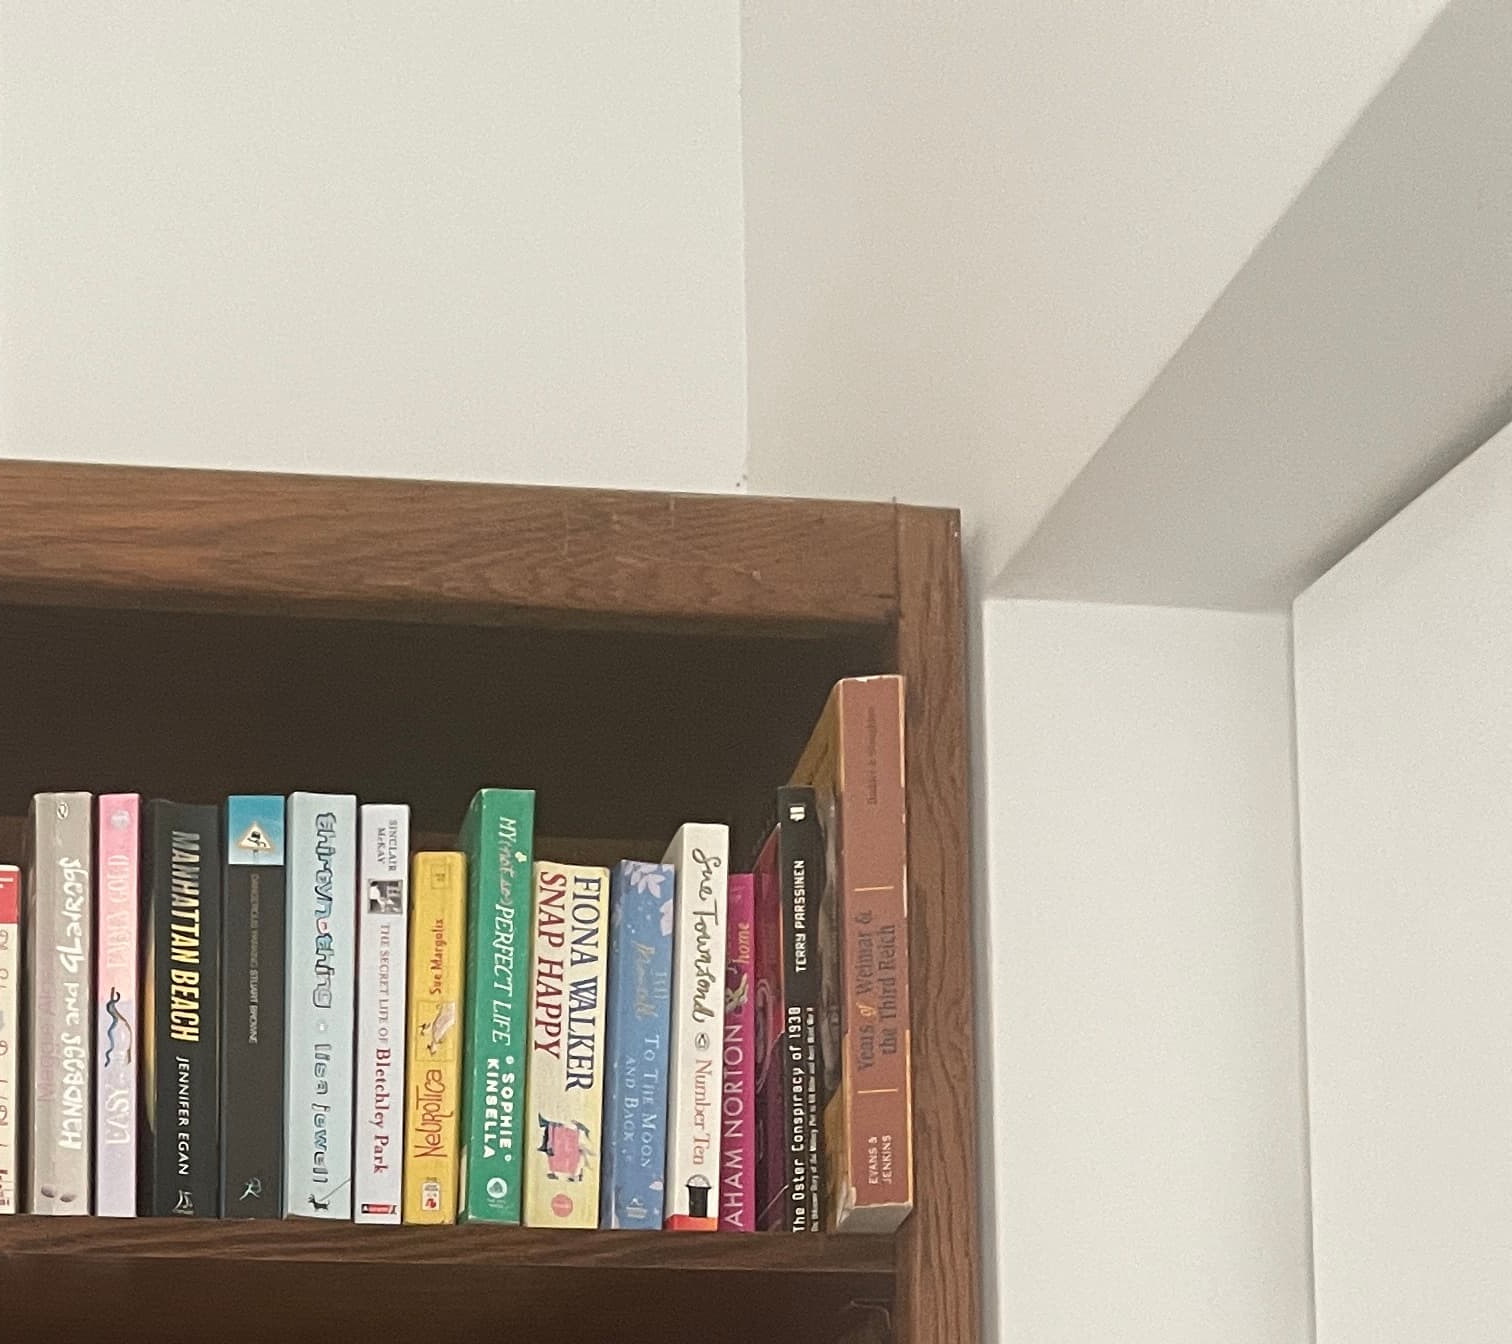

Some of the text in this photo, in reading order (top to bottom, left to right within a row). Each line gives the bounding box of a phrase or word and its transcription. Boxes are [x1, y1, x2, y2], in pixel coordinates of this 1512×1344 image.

[171, 831, 200, 1042] MANHATTAN BEACH
[533, 871, 567, 1059] SNAP HAPPY
[565, 876, 601, 1092] FIONA WALKER
[176, 1057, 189, 1175] JENNIFER EGAN
[371, 1048, 392, 1173] Bletchley Park
[483, 1058, 499, 1160] KINSELLA
[499, 1073, 514, 1152] SOPHIE
